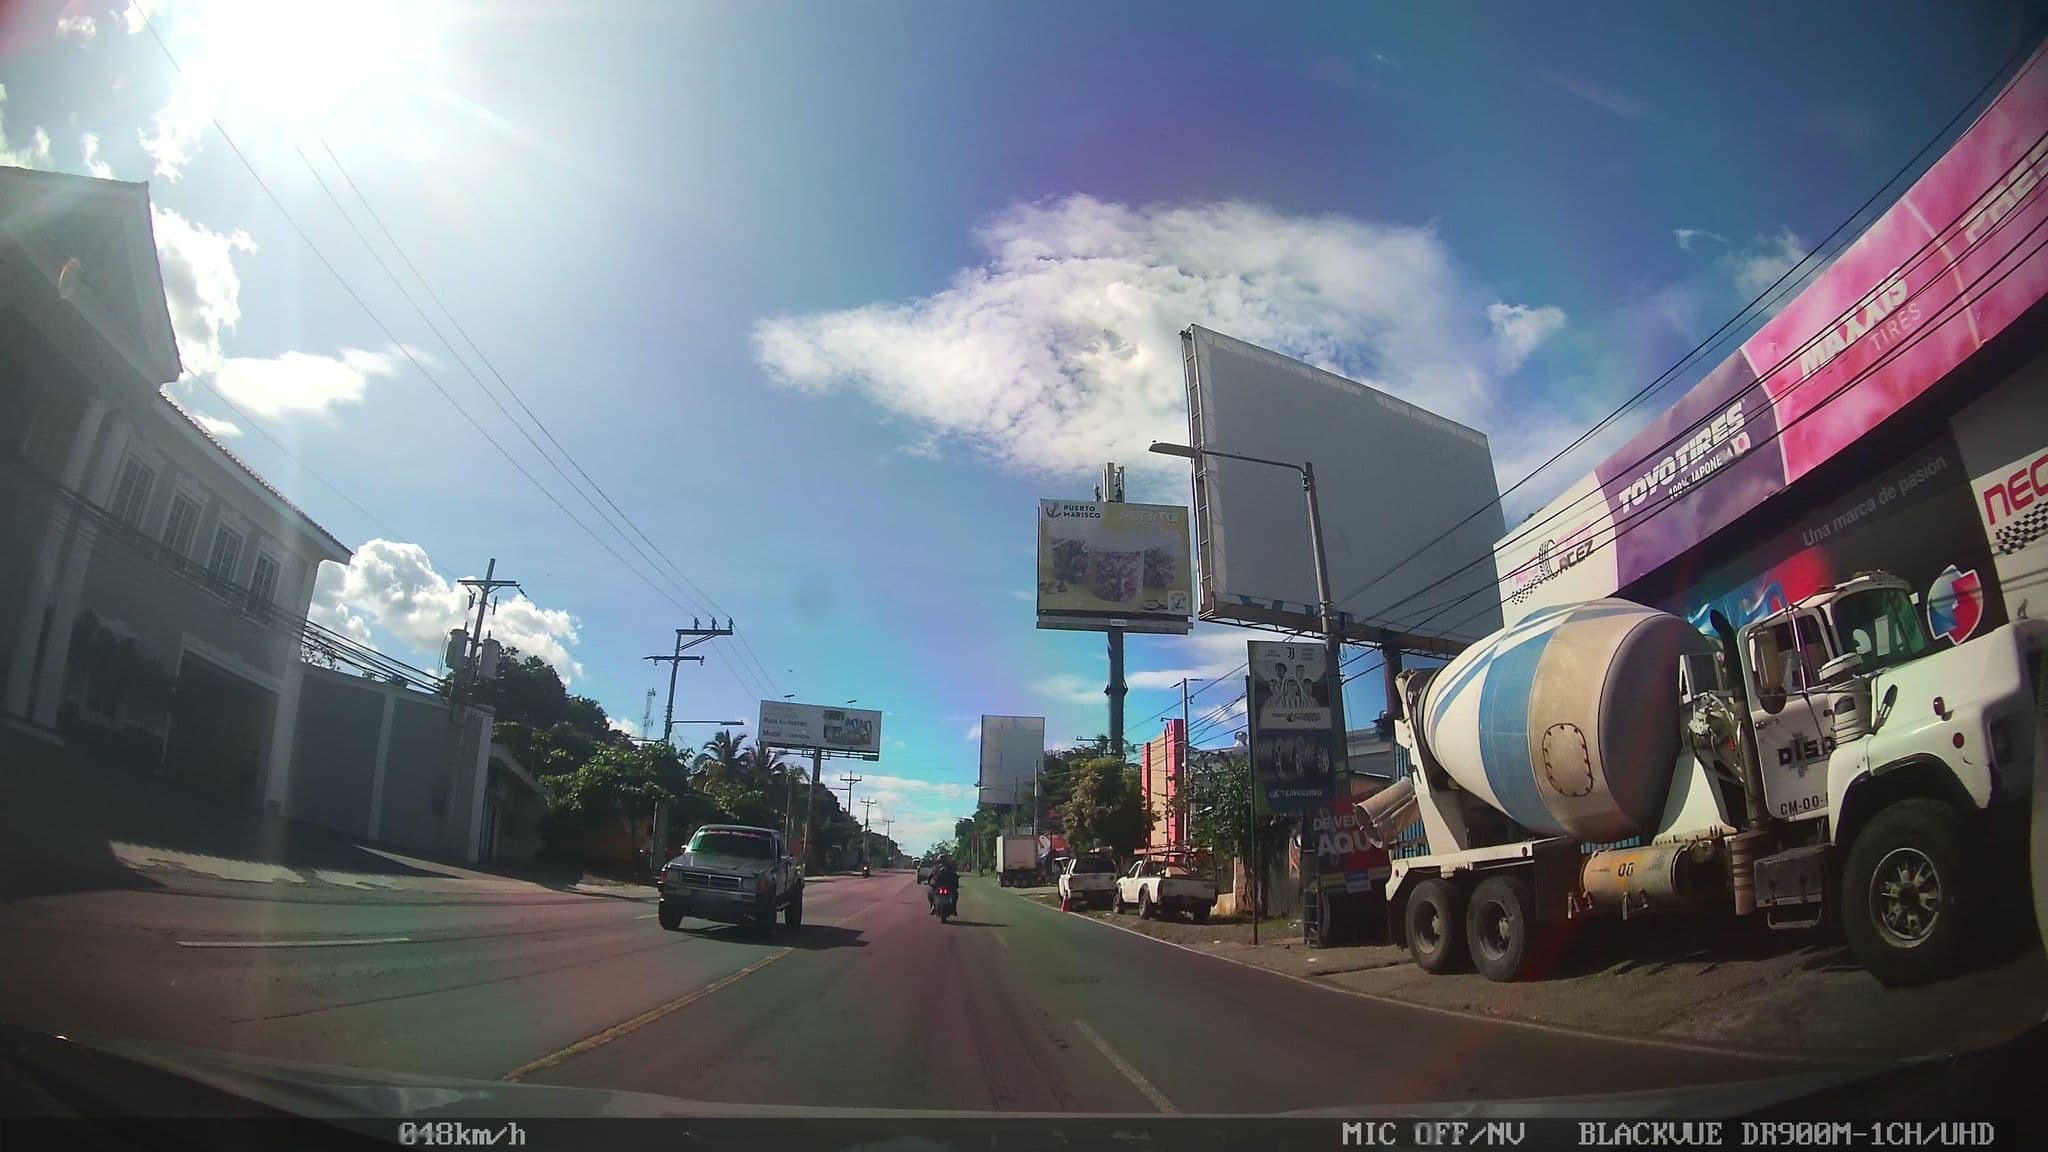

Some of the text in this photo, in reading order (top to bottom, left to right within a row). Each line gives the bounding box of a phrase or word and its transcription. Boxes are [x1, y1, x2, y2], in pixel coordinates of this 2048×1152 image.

[1799, 266, 1908, 381] MAXXIS
[1869, 301, 1922, 352] TIRES
[1618, 402, 1746, 514] TOYO TIRES
[1063, 511, 1101, 519] MARISCO
[1802, 523, 1831, 547] Una
[1833, 498, 1877, 531] marca
[1879, 483, 1897, 506] de
[1284, 789, 1323, 798] LINGLONG
